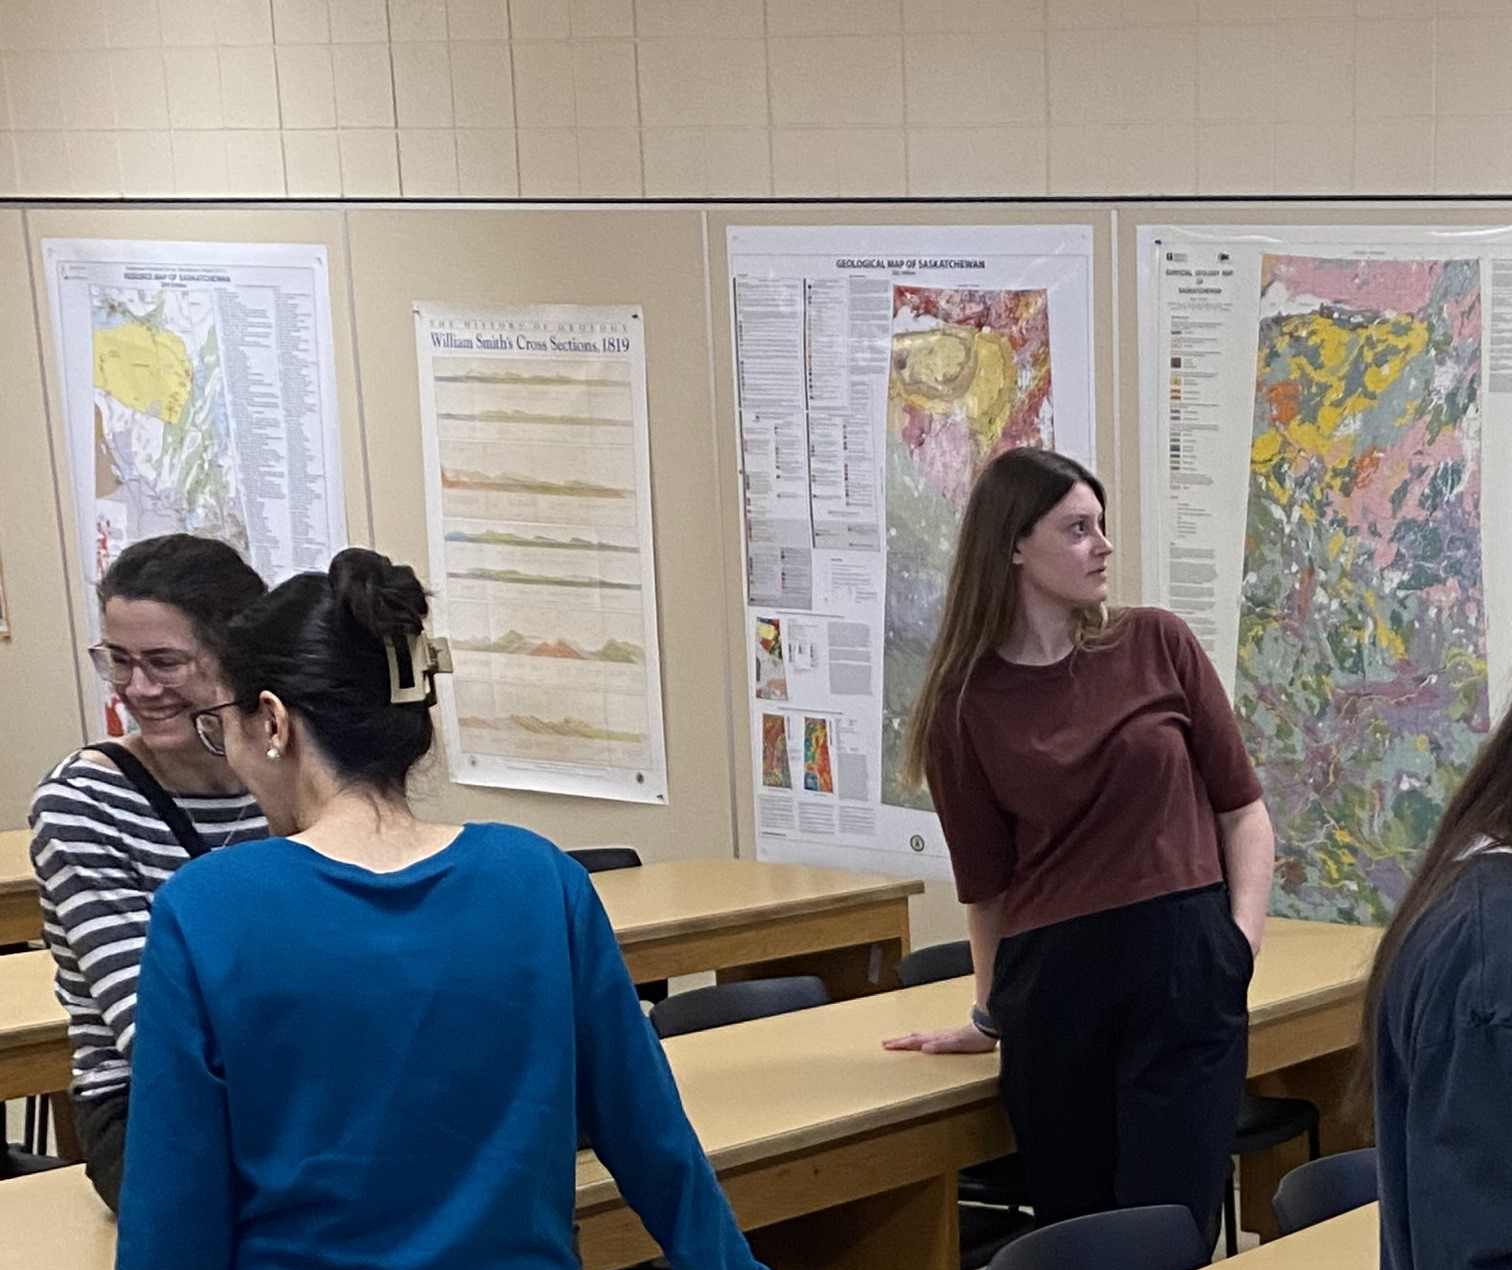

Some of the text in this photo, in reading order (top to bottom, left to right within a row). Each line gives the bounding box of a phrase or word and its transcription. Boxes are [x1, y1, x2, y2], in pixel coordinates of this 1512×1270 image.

[835, 258, 986, 269] GEOLOGICAL MAP OF SASKATCHEWAN
[430, 332, 473, 349] William
[475, 333, 513, 350] Smith's
[516, 334, 547, 351] Cross
[602, 337, 630, 353] 1819
